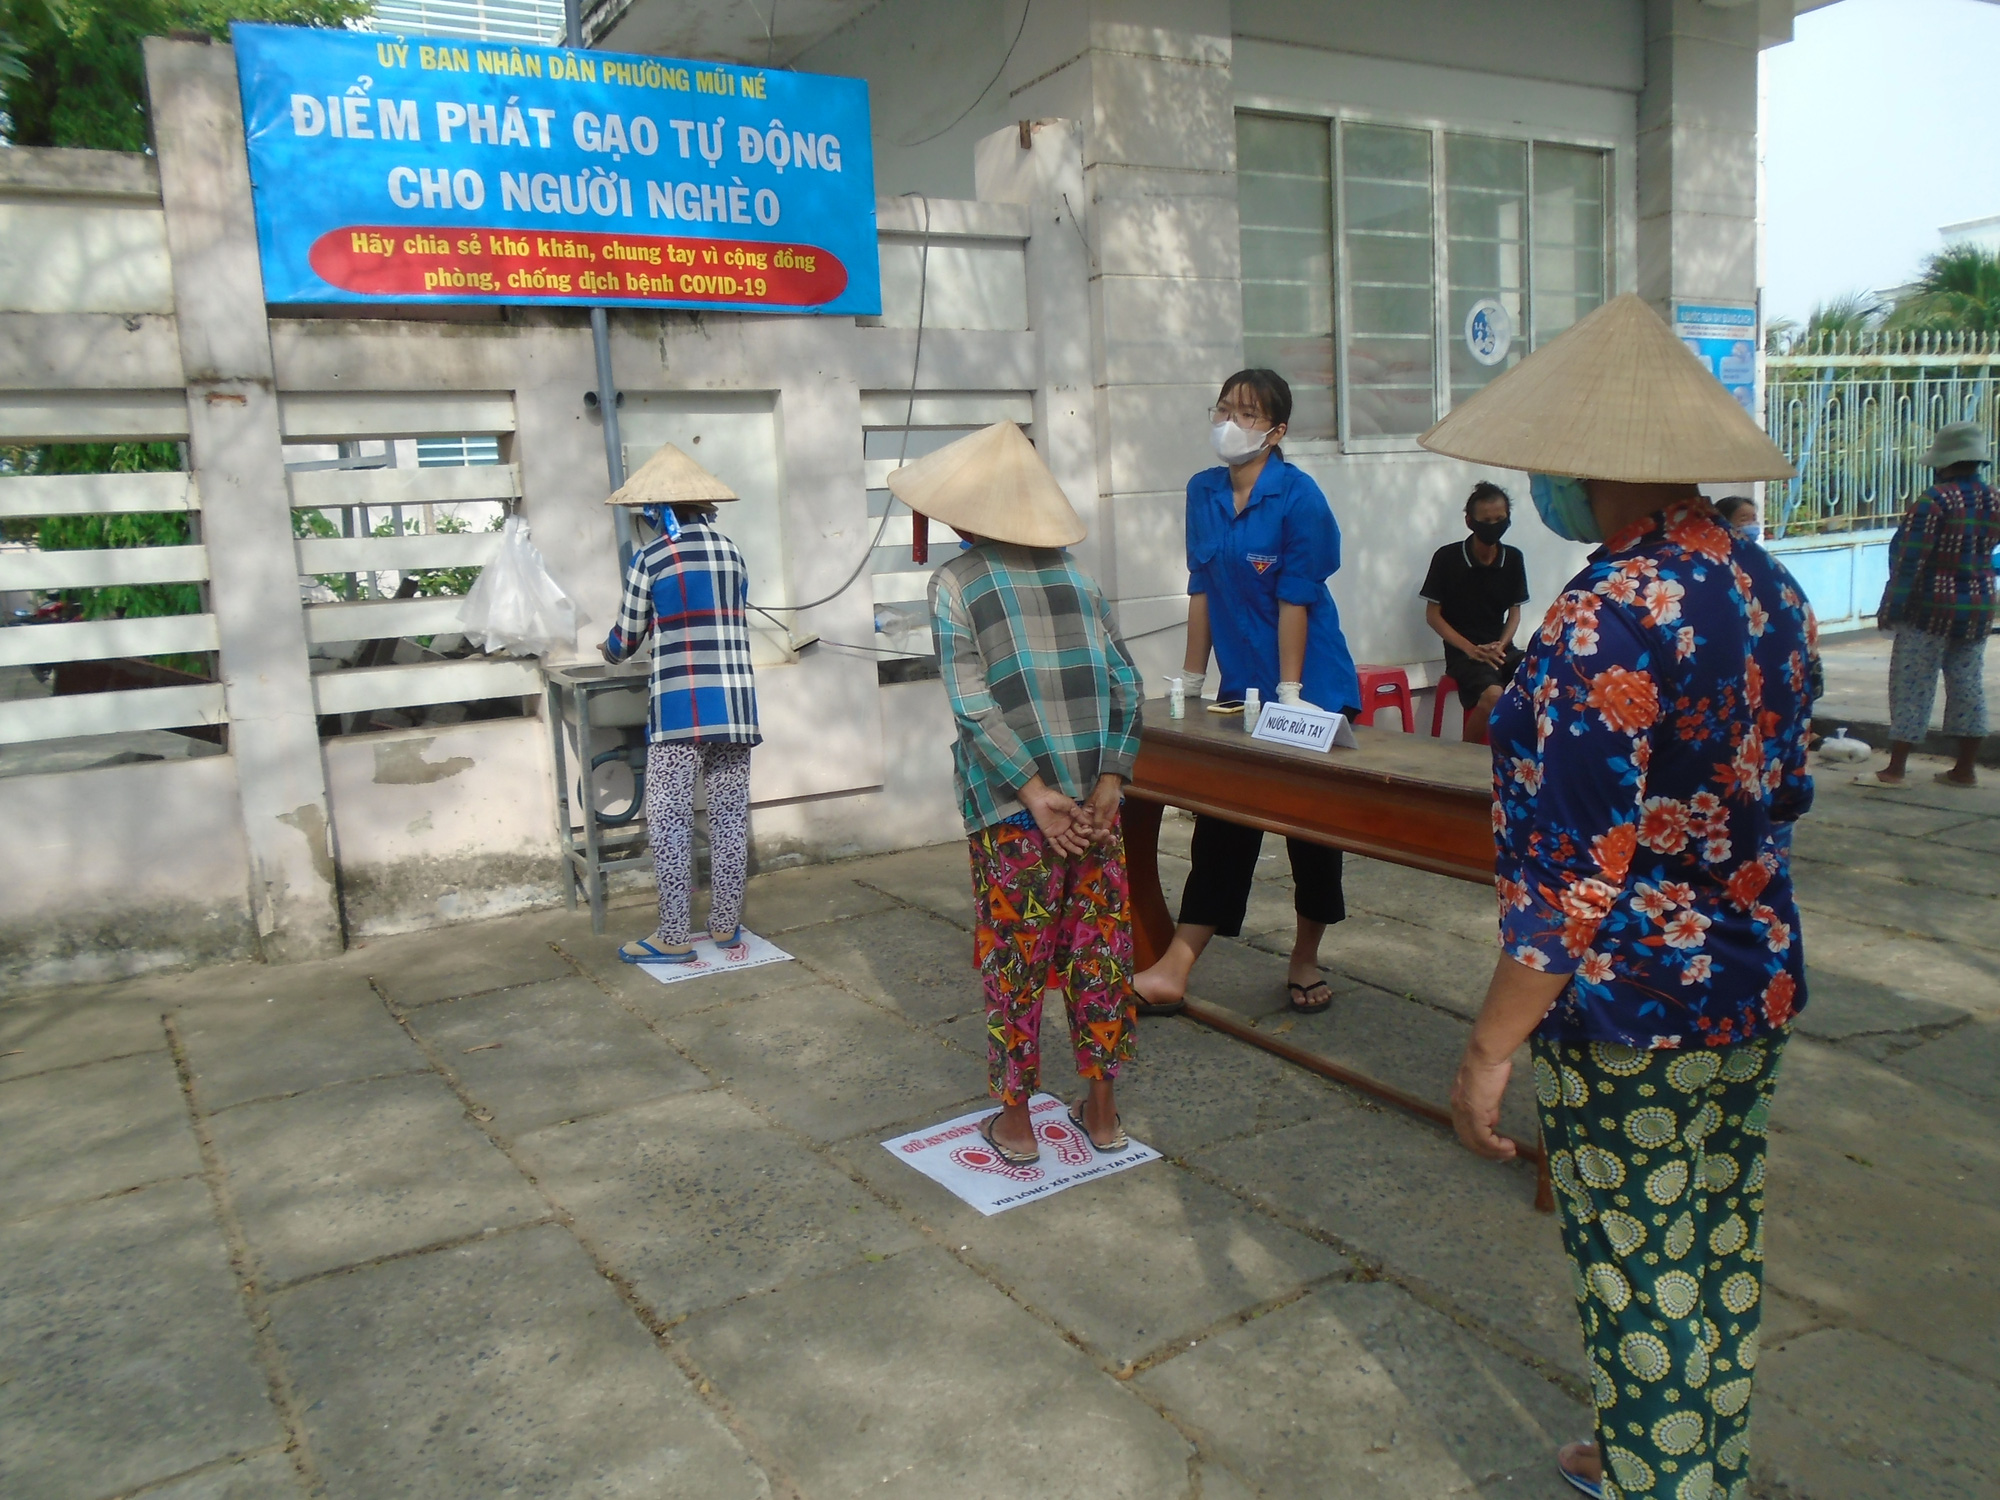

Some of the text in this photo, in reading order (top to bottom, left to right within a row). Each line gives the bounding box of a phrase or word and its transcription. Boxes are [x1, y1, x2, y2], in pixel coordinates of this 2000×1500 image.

[377, 35, 767, 99] UỶ BAN NHÂN DÂN PHƯỜNG MŨI NÉ
[290, 75, 842, 175] ĐIỂM PHÁT GẠO TỰ ĐỘNG
[387, 166, 781, 227] CHO NGƯỜI NGHÈO
[351, 232, 816, 273] Hãy chia sẻ khó khăn, chung tay vì cộng đồng
[424, 267, 767, 297] phòng, chống dịch bệnh COVID-19
[1266, 714, 1289, 731] NƯỚC
[1290, 718, 1306, 736] RỬA
[1307, 724, 1326, 739] TAY
[991, 1150, 1149, 1207] VUI LÒNG XẾP HÀNG TẠI ĐÂY
